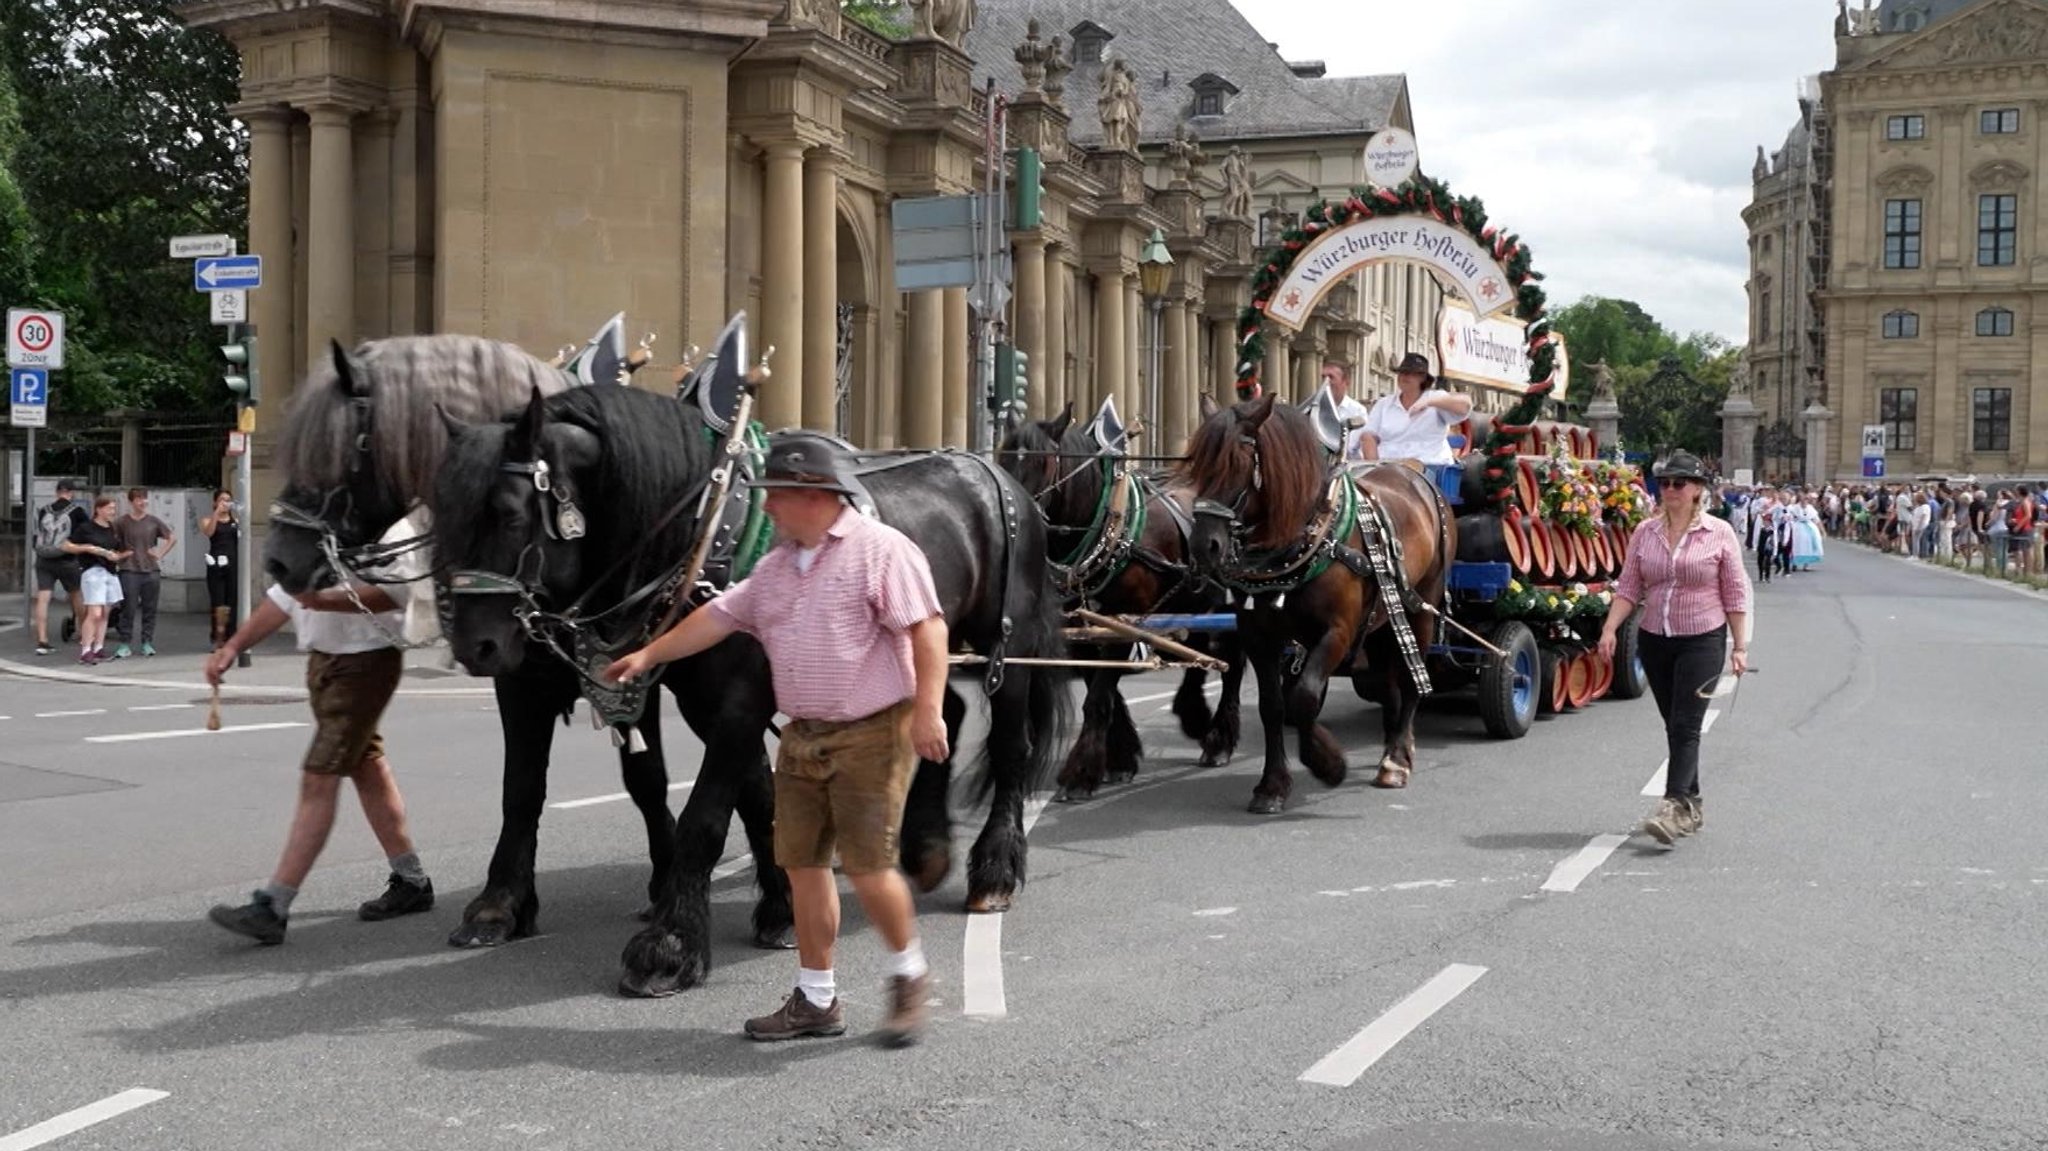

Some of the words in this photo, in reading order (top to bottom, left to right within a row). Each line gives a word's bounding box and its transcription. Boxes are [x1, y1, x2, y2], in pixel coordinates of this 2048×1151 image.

[1302, 229, 1408, 283] Würzburger
[1413, 227, 1478, 279] Hofbräu
[25, 325, 46, 341] 30
[21, 353, 48, 363] ZONE
[1463, 327, 1517, 372] Würzburger
[19, 373, 40, 403] P
